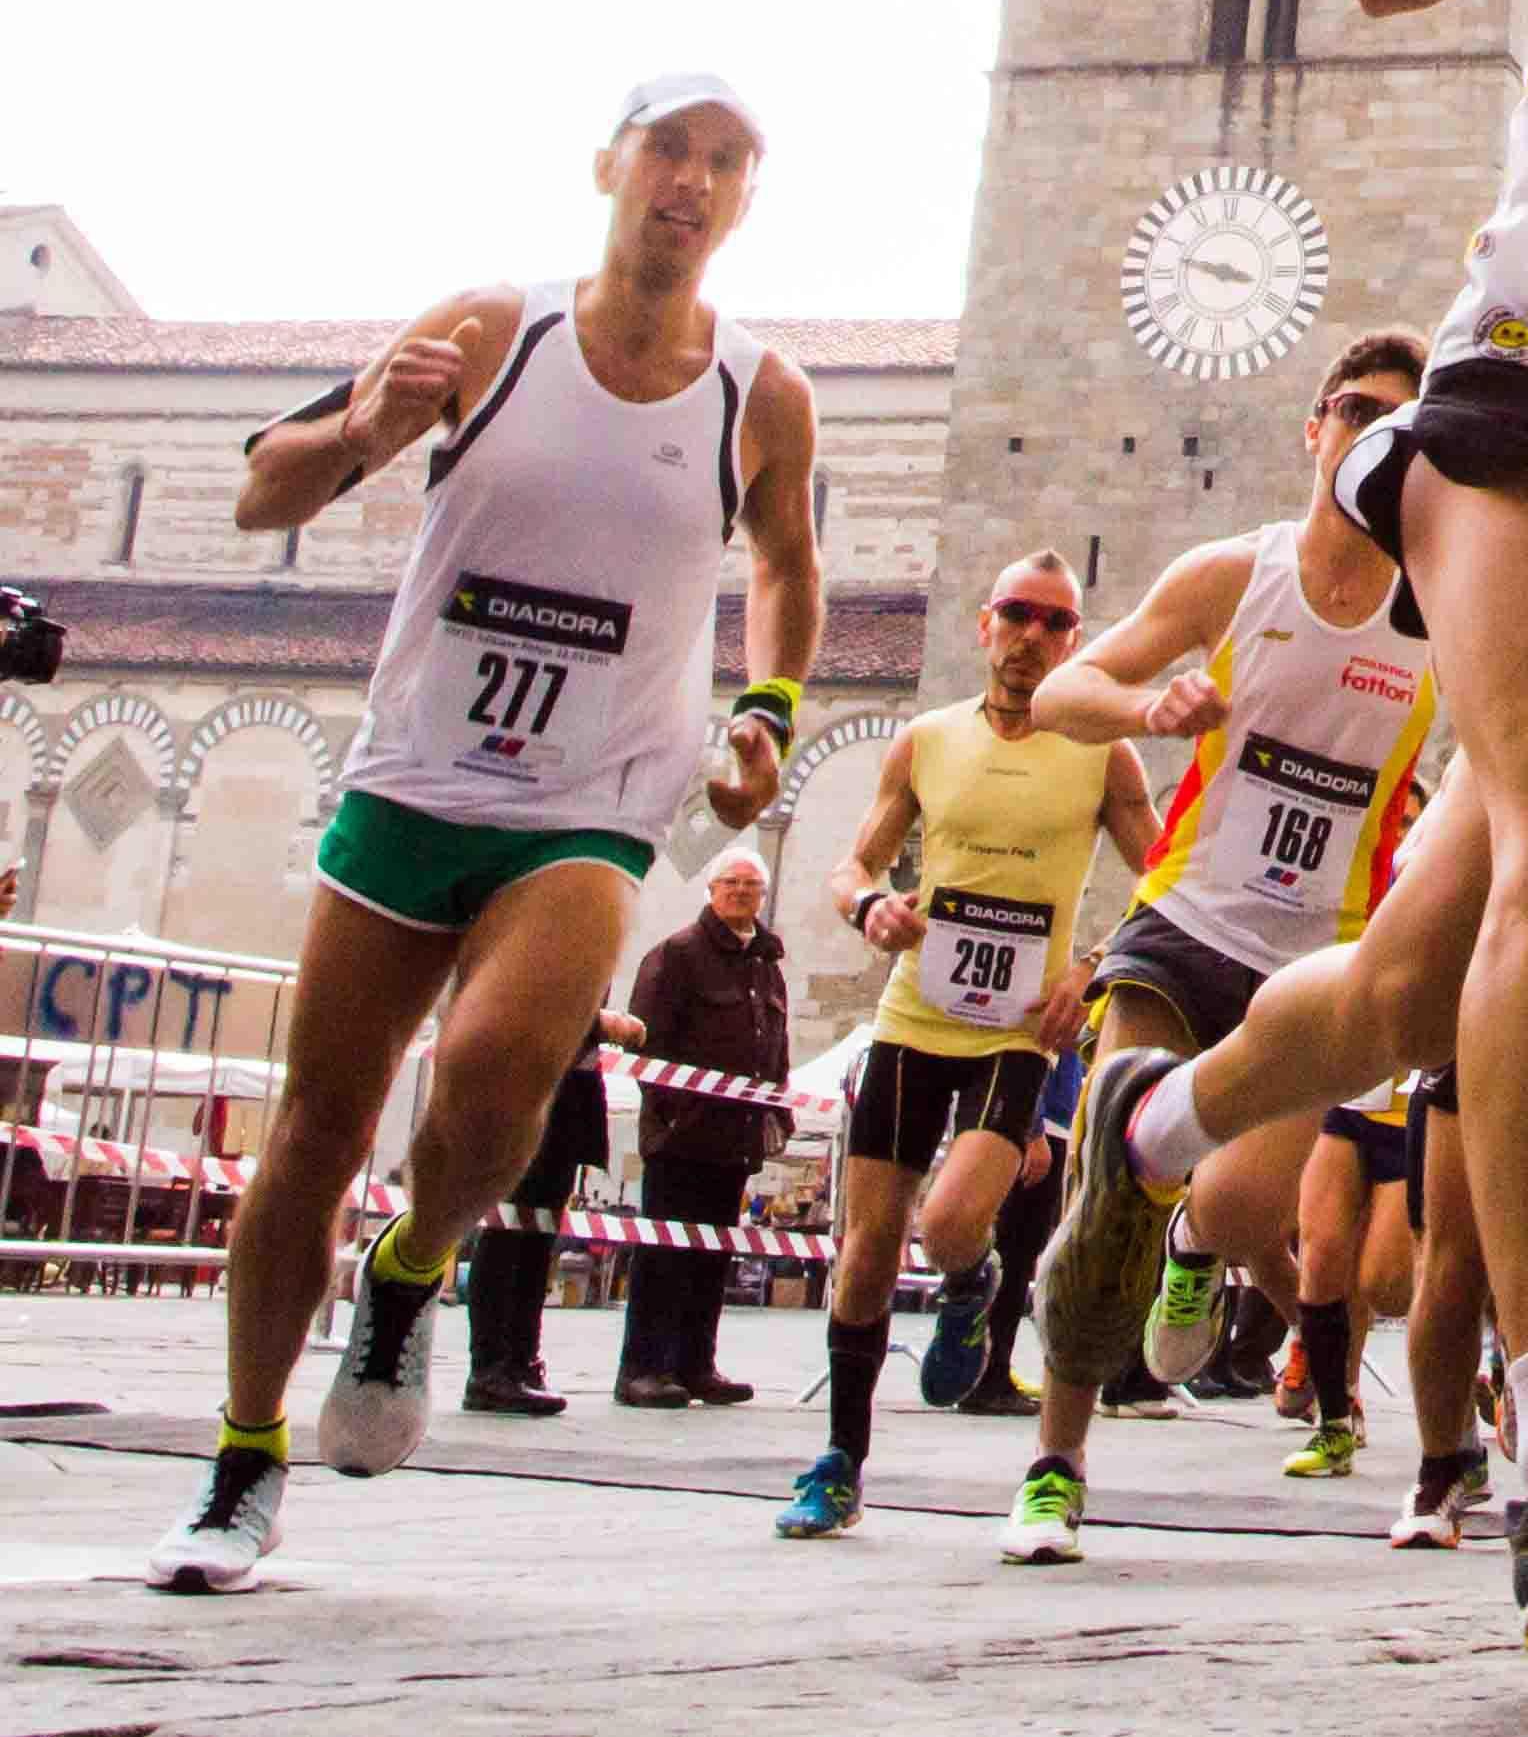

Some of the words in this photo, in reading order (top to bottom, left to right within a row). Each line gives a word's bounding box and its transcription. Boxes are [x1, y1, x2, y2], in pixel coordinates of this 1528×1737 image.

[487, 597, 617, 640] DIADORA
[467, 650, 569, 735] 277
[1280, 758, 1370, 798] DIADORA
[1260, 802, 1333, 872] 168
[963, 903, 1046, 929] DIADORA
[950, 937, 1017, 992] 298
[40, 954, 233, 1054] CPT
